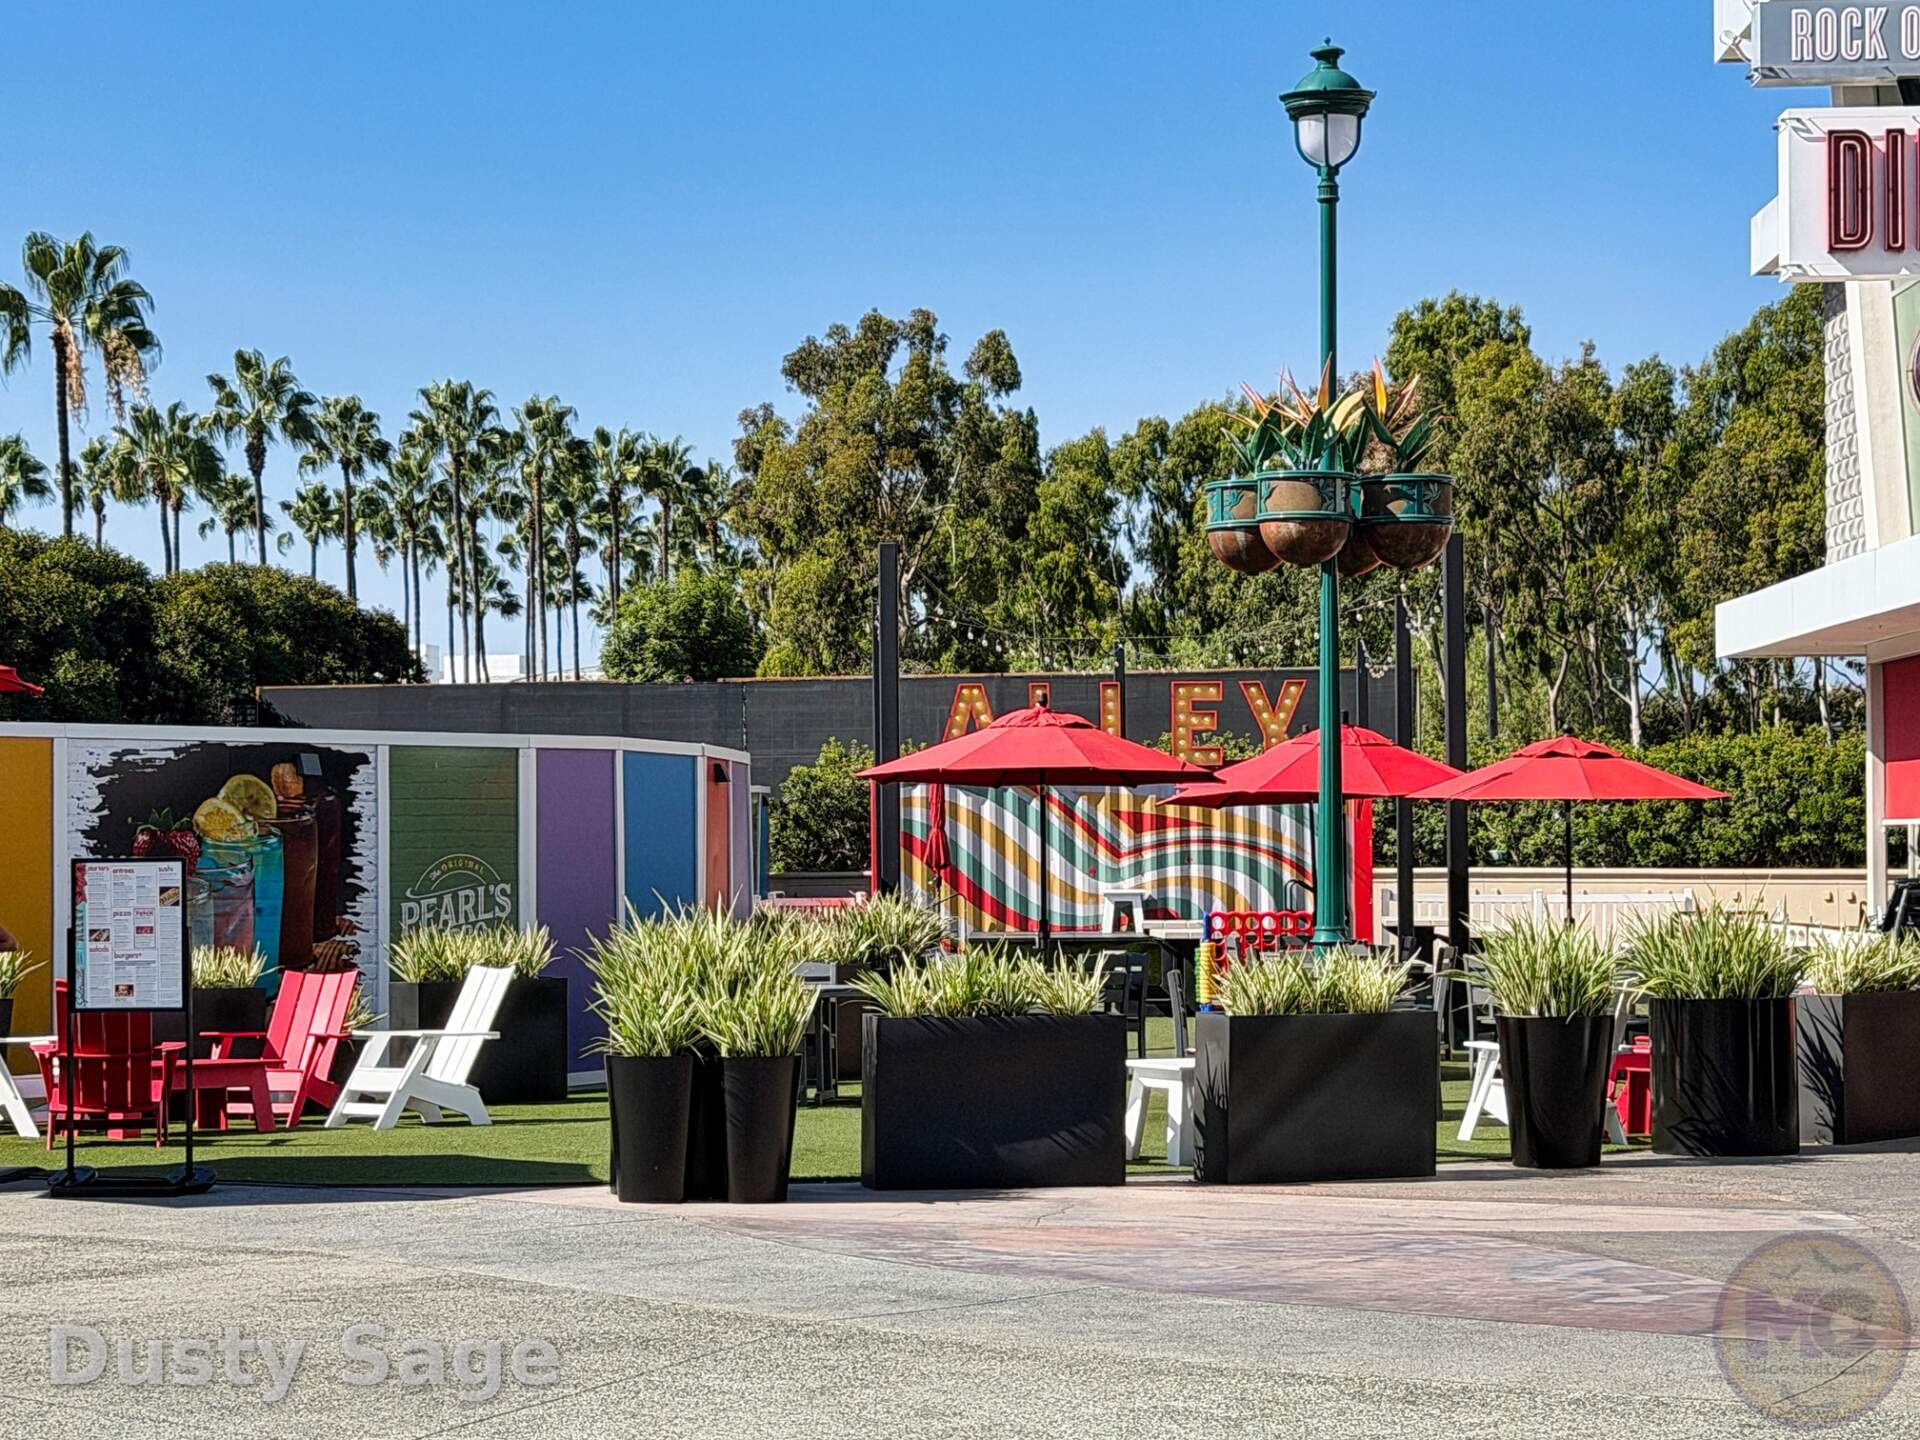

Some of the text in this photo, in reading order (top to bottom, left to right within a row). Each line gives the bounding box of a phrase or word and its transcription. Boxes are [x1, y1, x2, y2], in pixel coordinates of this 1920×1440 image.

[1791, 6, 1888, 62] ROCK
[1827, 128, 1920, 253] DI
[441, 859, 484, 875] ORIGINAL
[112, 910, 132, 918] pizza
[400, 883, 511, 932] PEARL'S
